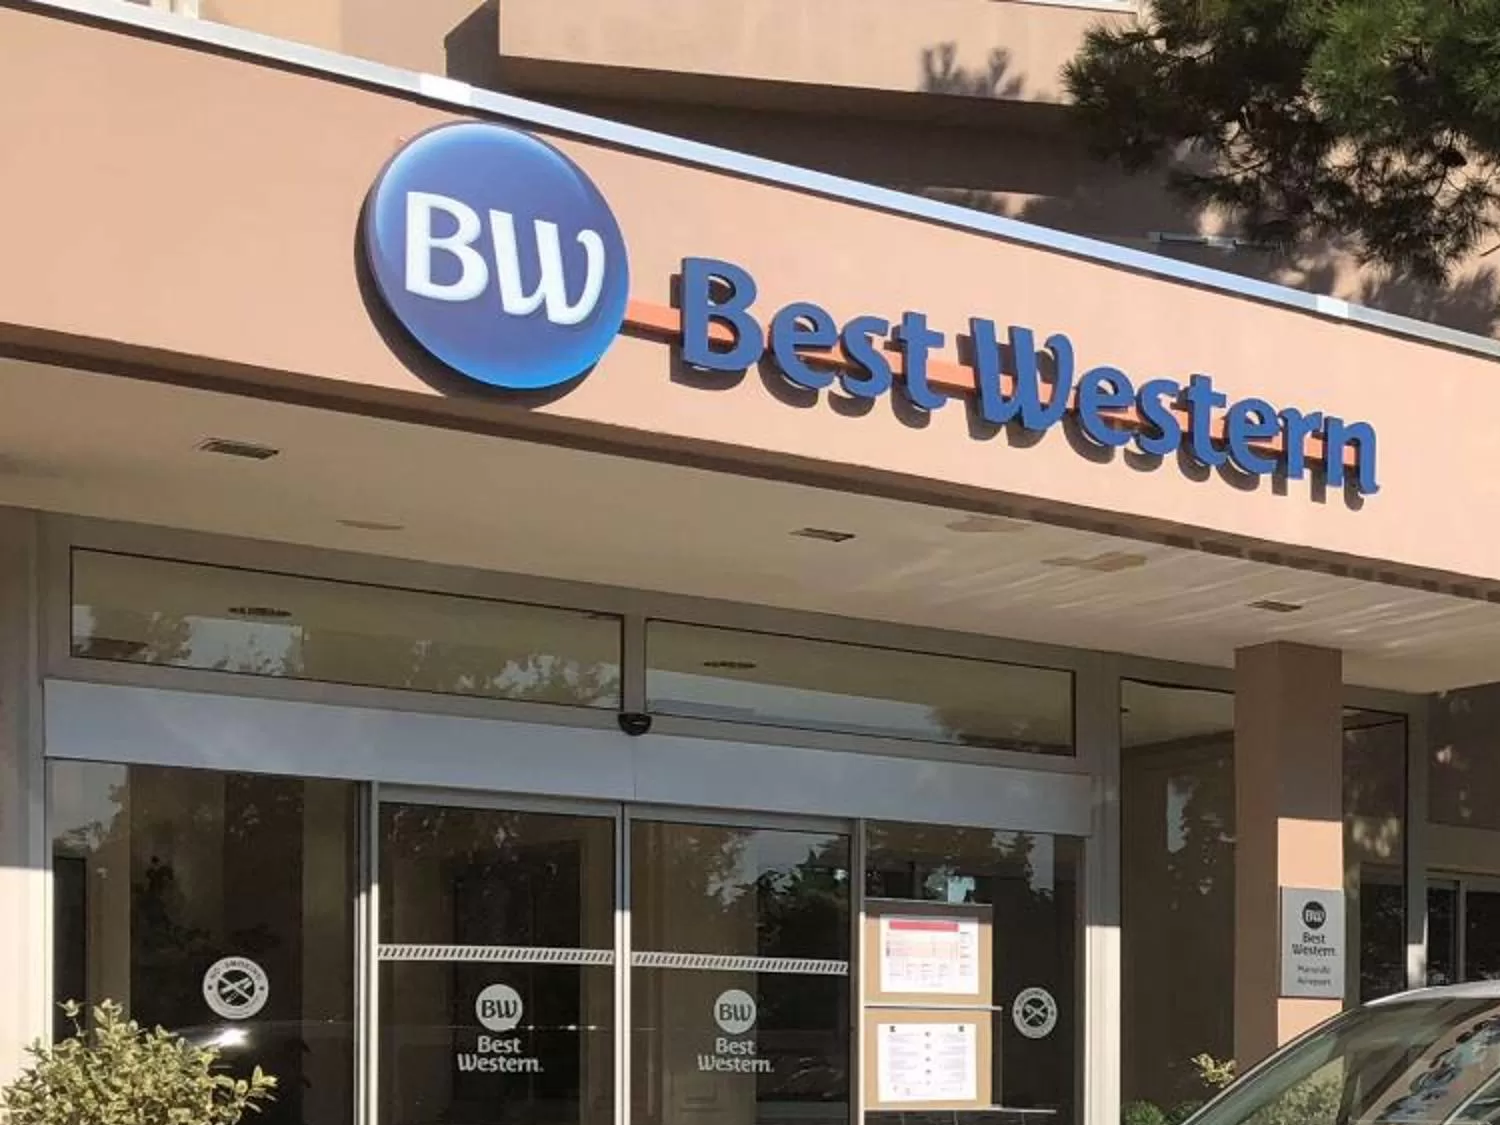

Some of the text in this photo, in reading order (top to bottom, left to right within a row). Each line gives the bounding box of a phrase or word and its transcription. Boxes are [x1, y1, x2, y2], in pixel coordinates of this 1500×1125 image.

[404, 190, 606, 326] BW
[680, 256, 1379, 494] Best Western
[1302, 931, 1327, 945] Best
[1291, 943, 1337, 957] Western
[481, 999, 519, 1019] BW
[719, 1003, 753, 1021] BW
[477, 1036, 522, 1054] Best
[715, 1038, 756, 1056] Best
[457, 1053, 540, 1073] Western
[697, 1055, 771, 1073] Western
